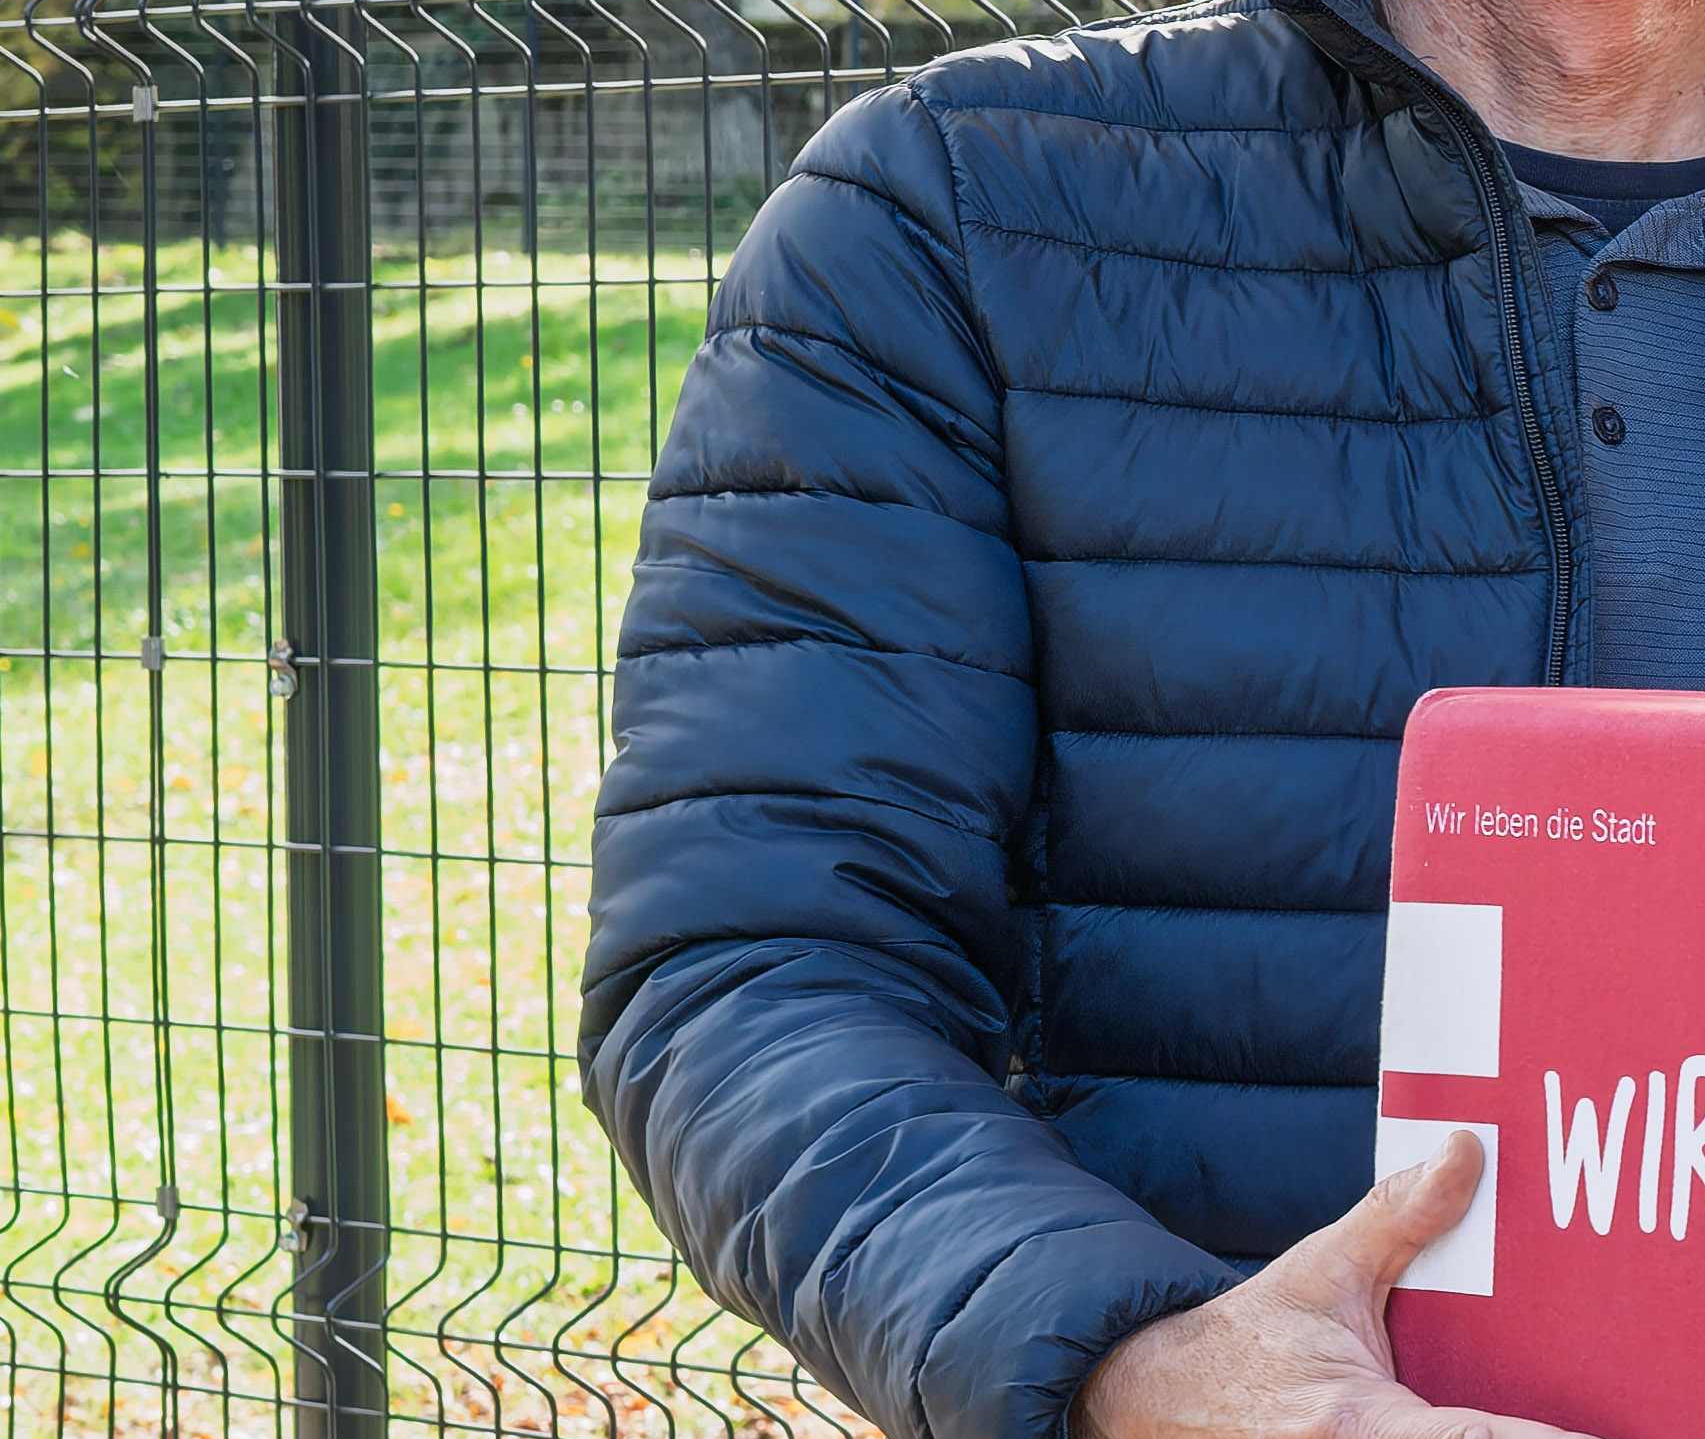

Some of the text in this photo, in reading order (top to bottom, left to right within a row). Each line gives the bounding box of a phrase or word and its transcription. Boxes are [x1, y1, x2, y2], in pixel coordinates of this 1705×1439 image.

[1425, 802, 1657, 845] Wir leben die Stadt
